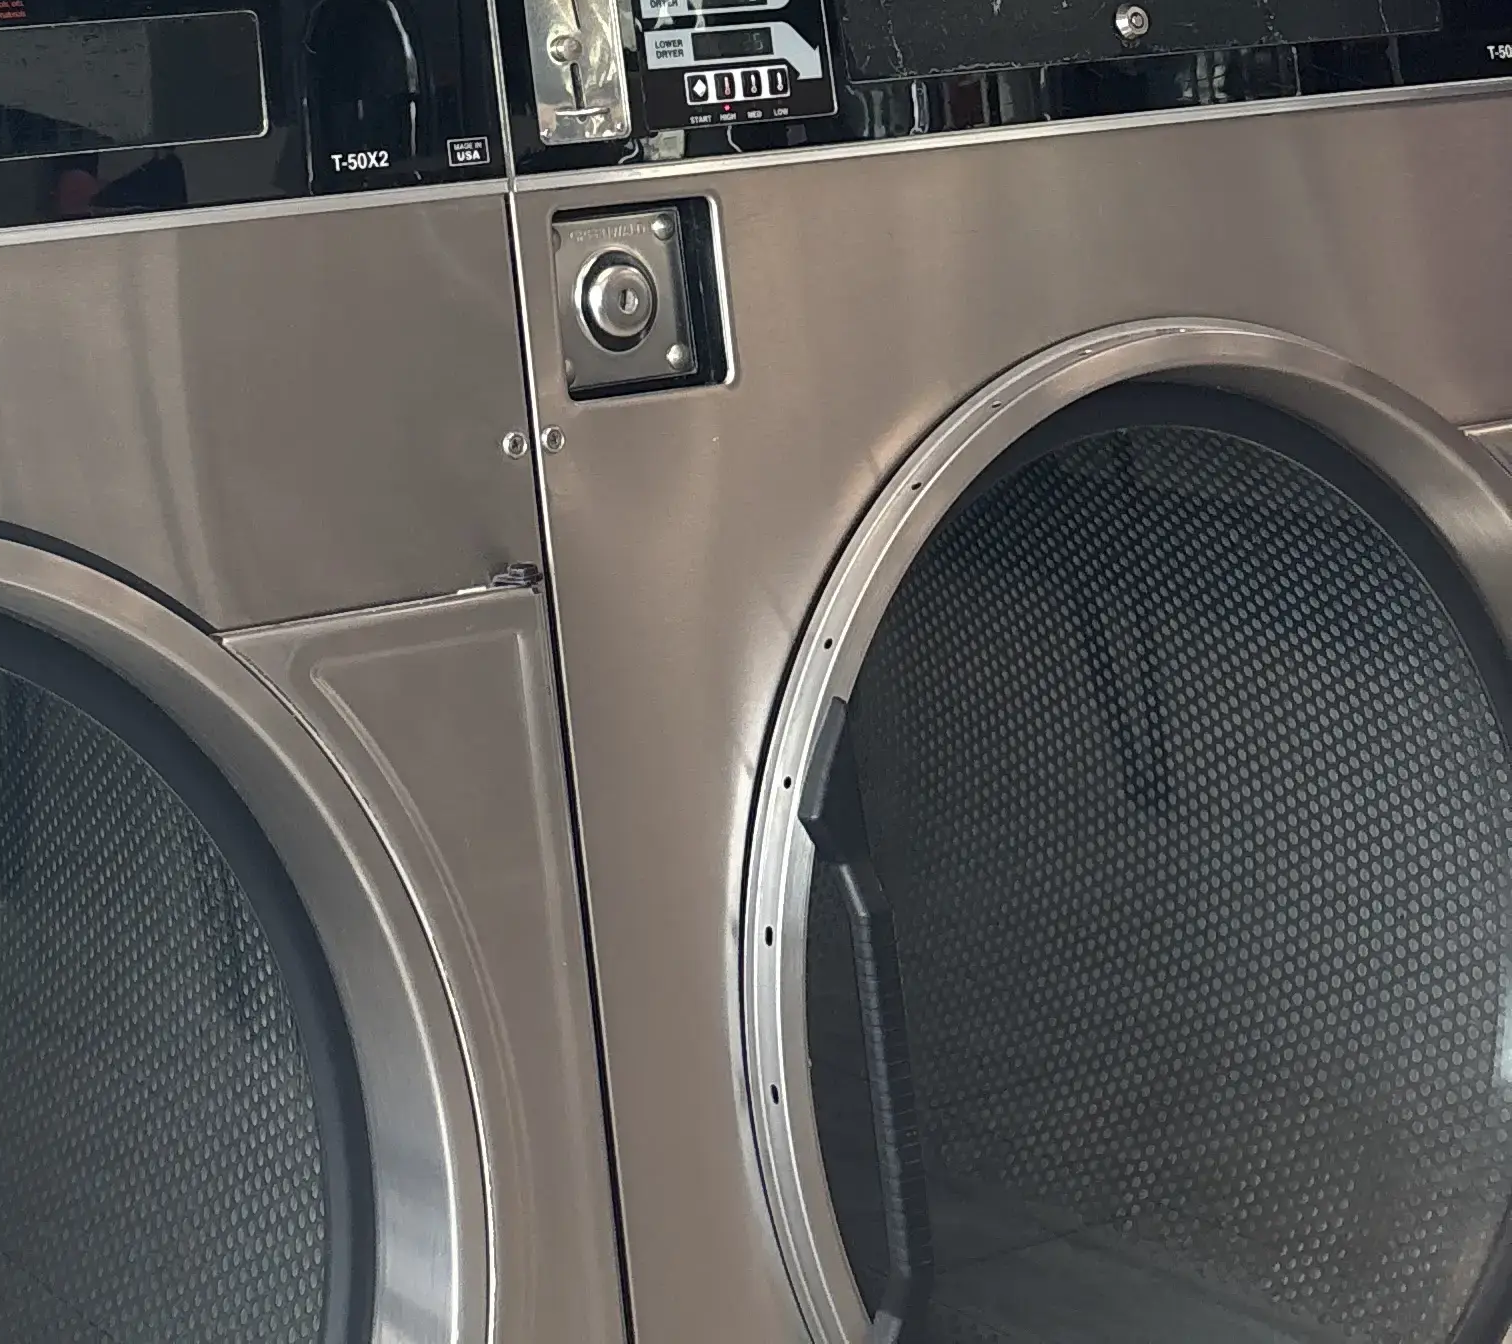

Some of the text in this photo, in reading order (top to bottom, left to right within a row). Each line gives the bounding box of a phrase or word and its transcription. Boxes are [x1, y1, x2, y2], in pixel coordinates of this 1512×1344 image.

[655, 39, 683, 49] LOWER
[656, 49, 684, 59] DRYER
[690, 108, 788, 125] START HIGH MED LOW
[331, 150, 390, 172] T-50X2
[457, 150, 480, 161] USA
